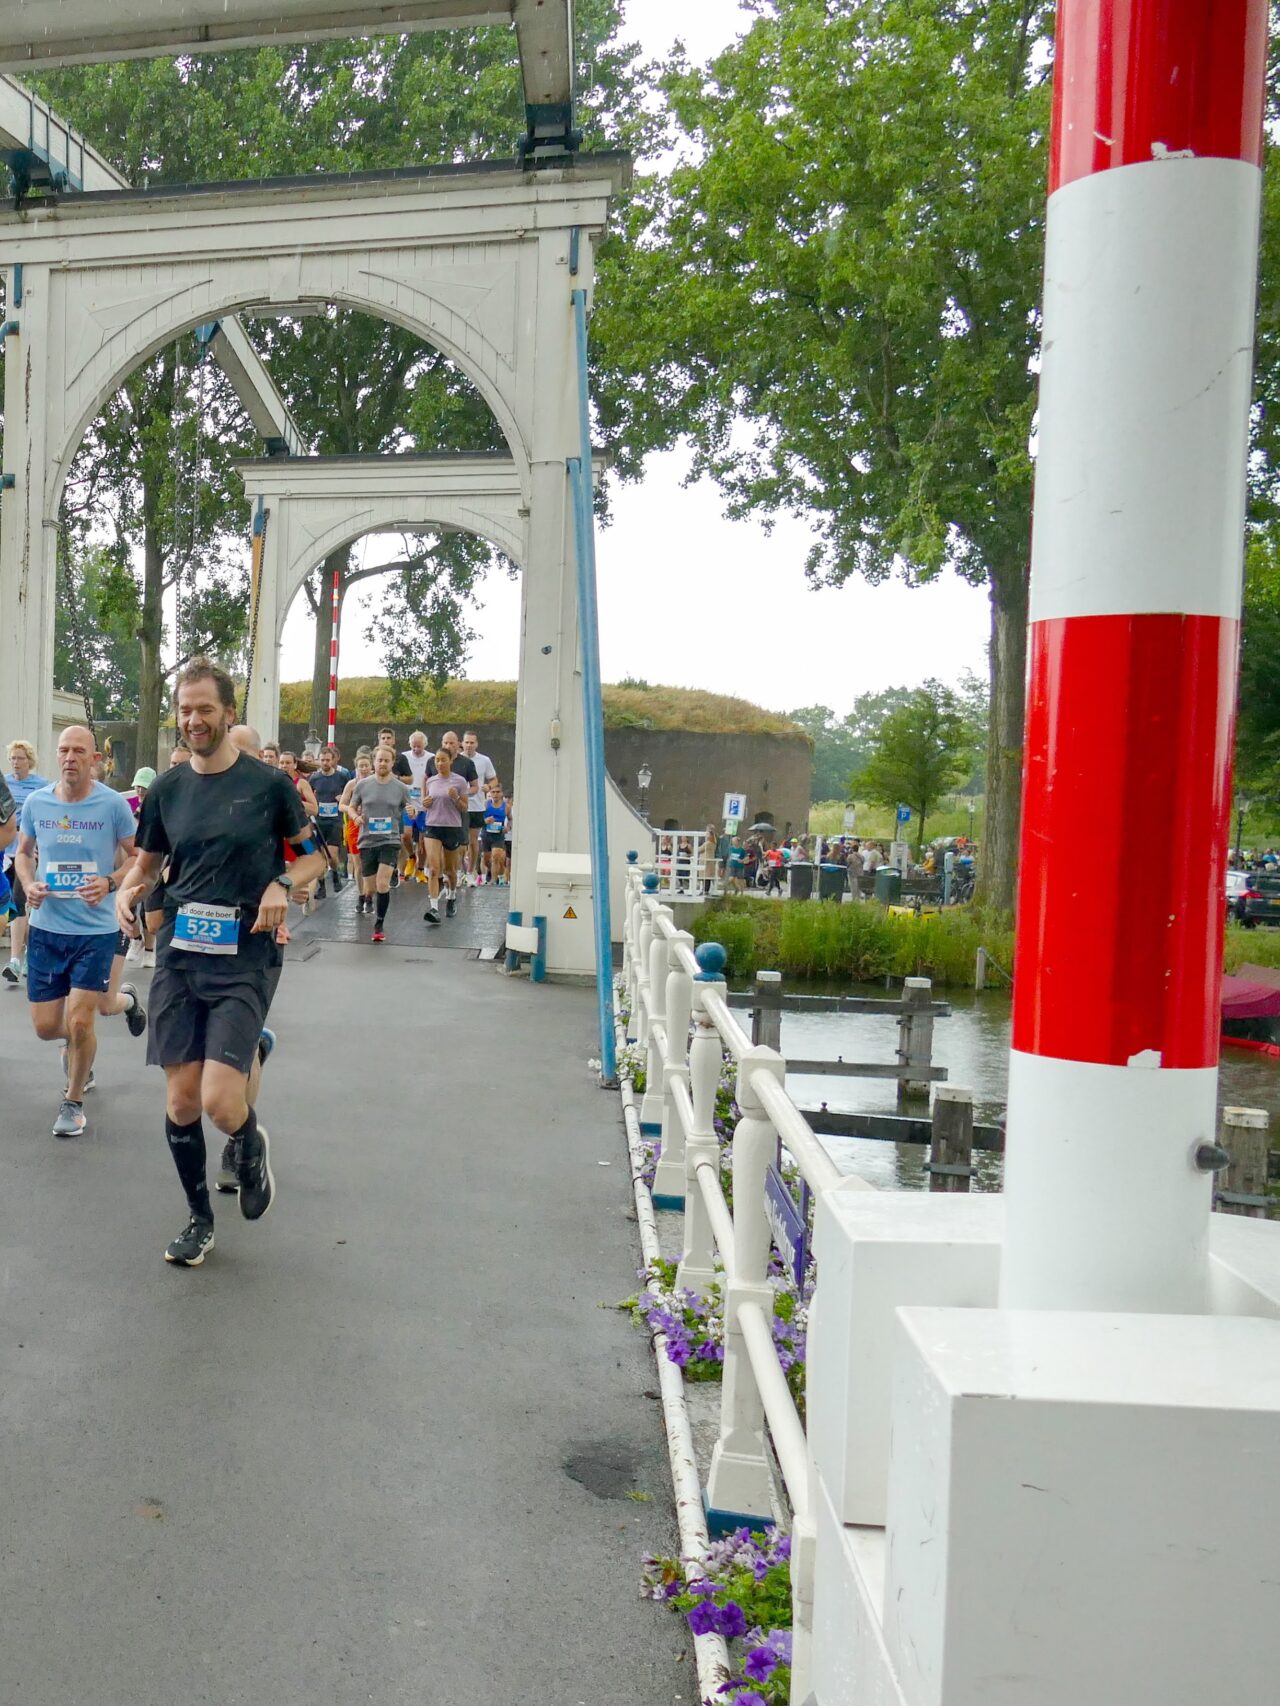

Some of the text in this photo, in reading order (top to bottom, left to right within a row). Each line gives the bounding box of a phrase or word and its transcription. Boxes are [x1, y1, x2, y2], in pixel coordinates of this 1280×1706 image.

[57, 834, 82, 844] 2024
[54, 874, 89, 886] 1024
[187, 918, 222, 938] 523
